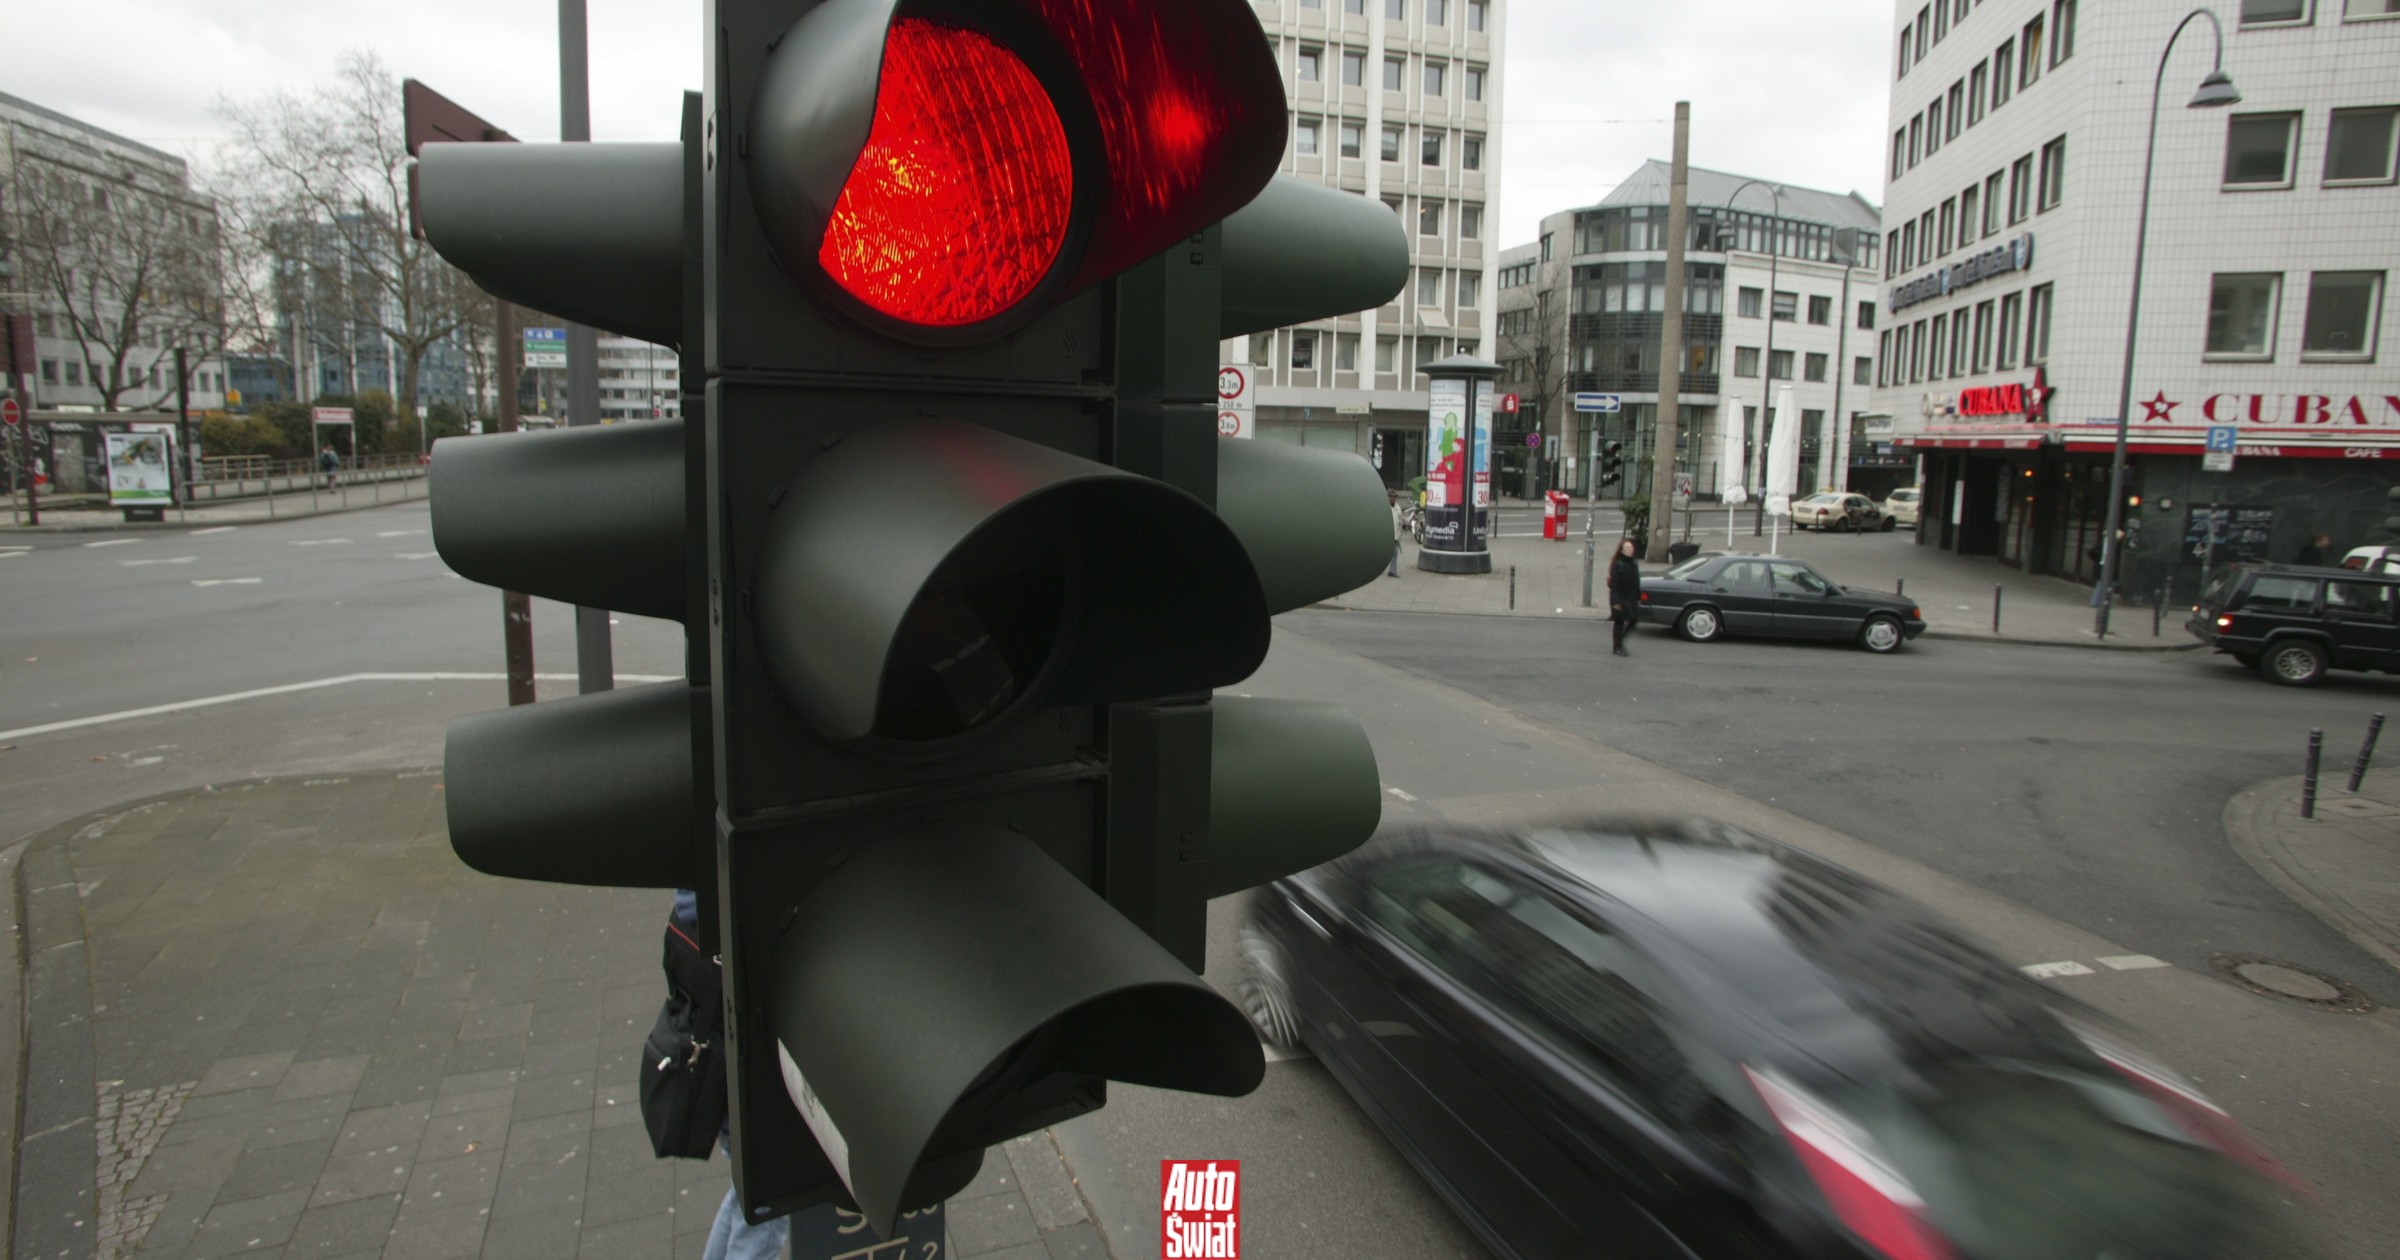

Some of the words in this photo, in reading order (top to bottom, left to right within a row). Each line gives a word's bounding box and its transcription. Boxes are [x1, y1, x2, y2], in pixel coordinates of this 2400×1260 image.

[1959, 383, 2023, 416] CUBANA
[2211, 429, 2229, 448] P
[2229, 446, 2281, 457] UBANA
